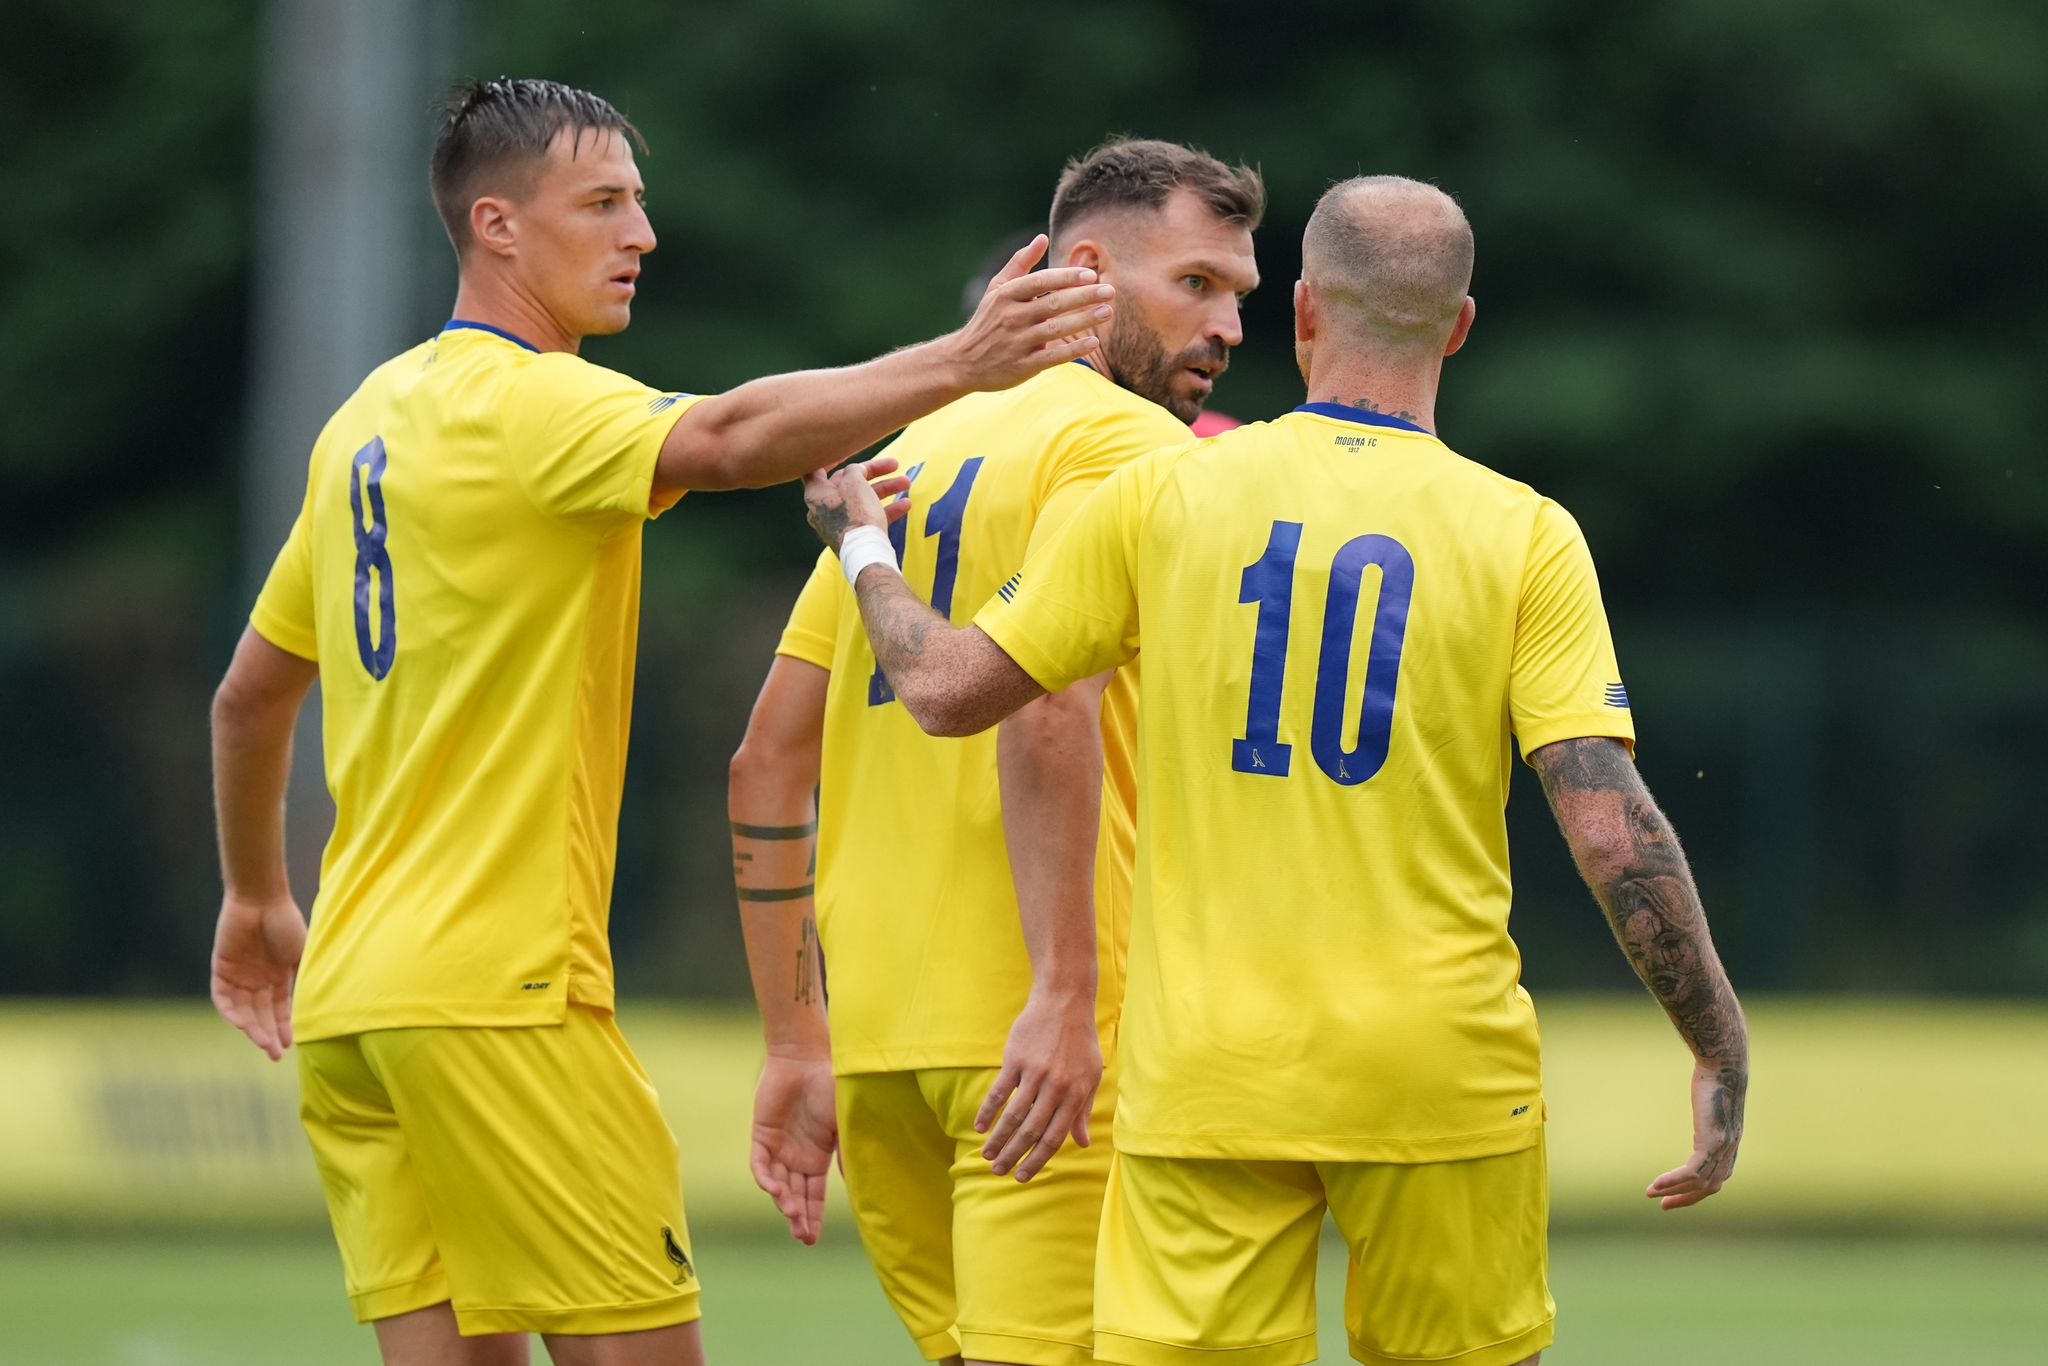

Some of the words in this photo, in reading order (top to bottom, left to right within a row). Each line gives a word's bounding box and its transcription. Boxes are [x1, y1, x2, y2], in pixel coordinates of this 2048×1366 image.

[350, 434, 396, 682] 8
[1334, 435, 1365, 447] MODENA
[1367, 438, 1378, 448] FC
[1231, 519, 1415, 787] 10
